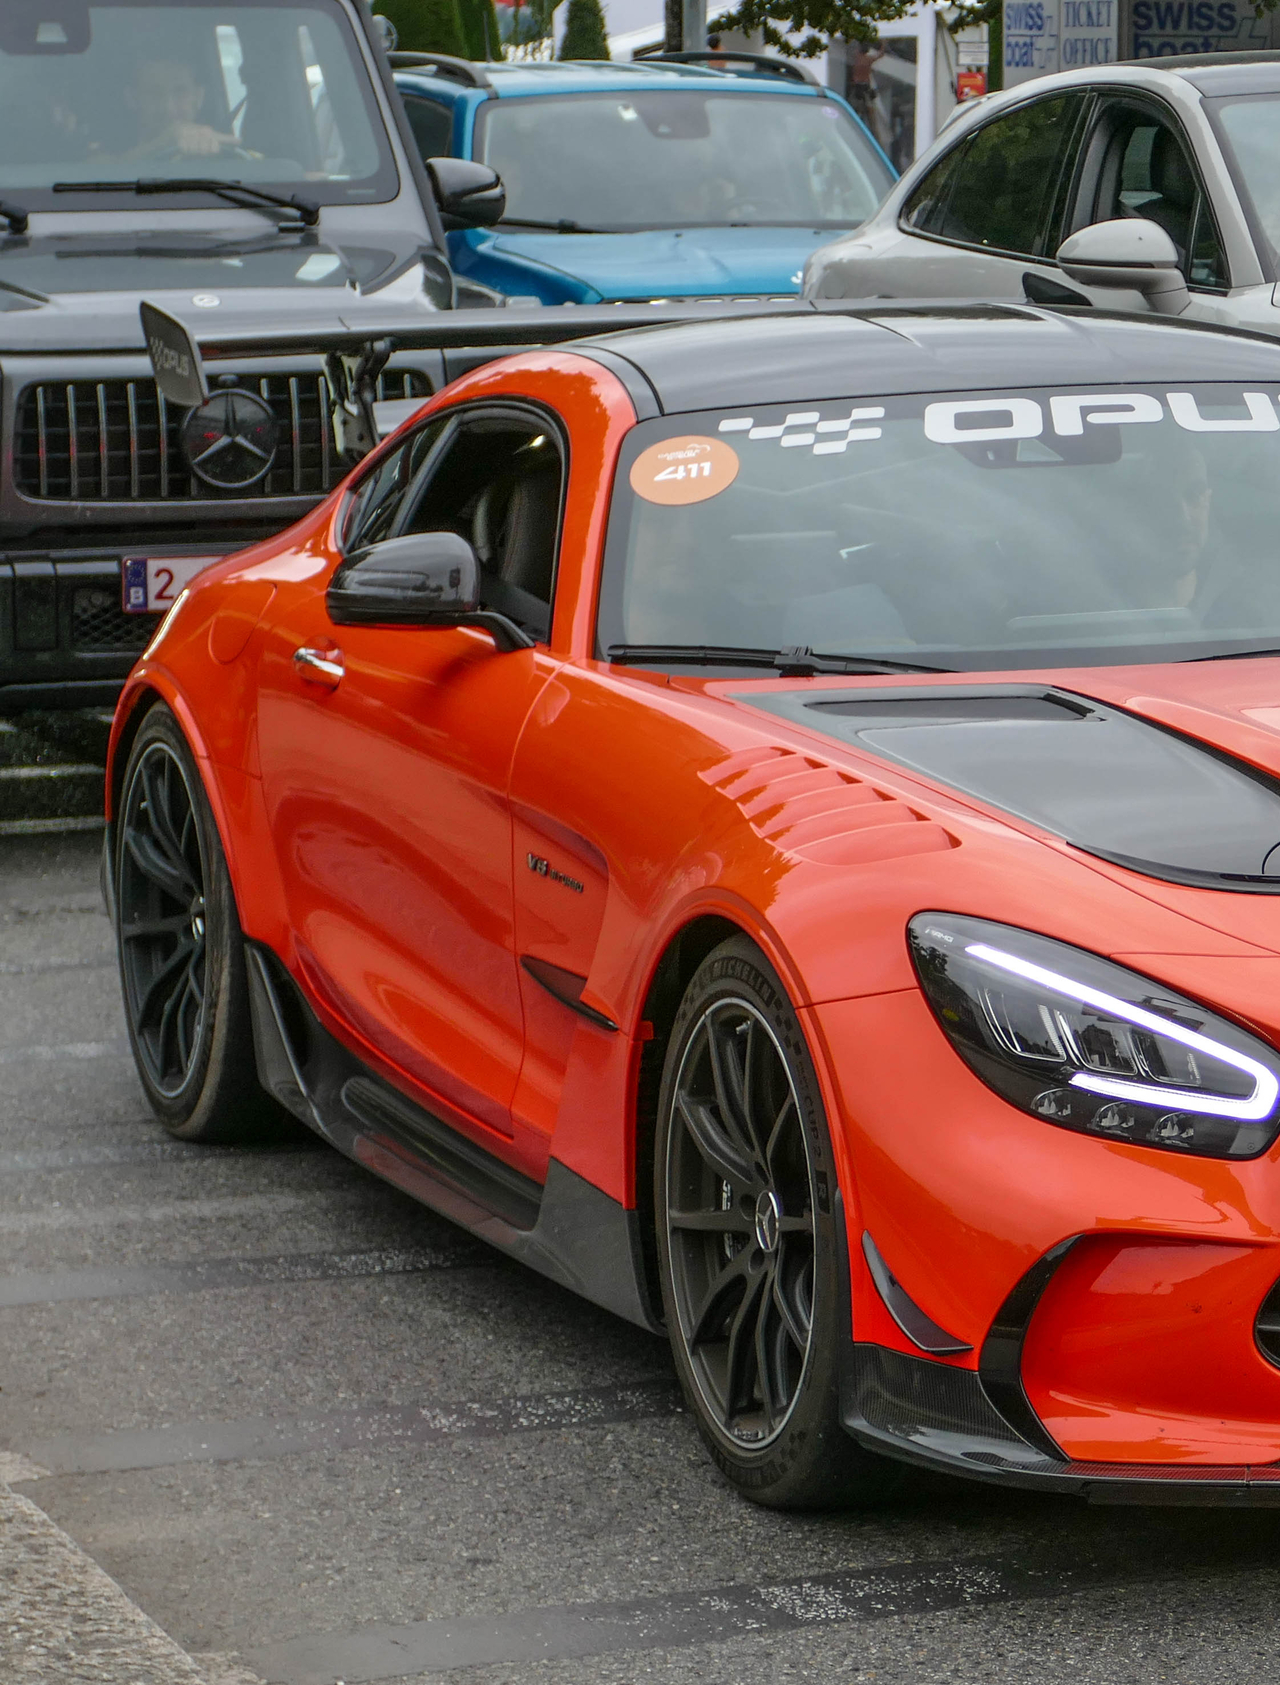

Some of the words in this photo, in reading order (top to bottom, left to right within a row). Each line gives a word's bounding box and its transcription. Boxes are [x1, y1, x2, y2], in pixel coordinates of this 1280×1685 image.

[1064, 1, 1112, 29] TICKET
[1006, 36, 1035, 68] boat
[1064, 37, 1112, 65] OFFICE
[653, 461, 711, 482] 411
[526, 852, 548, 877] V8
[712, 957, 775, 1005] MICHELIN
